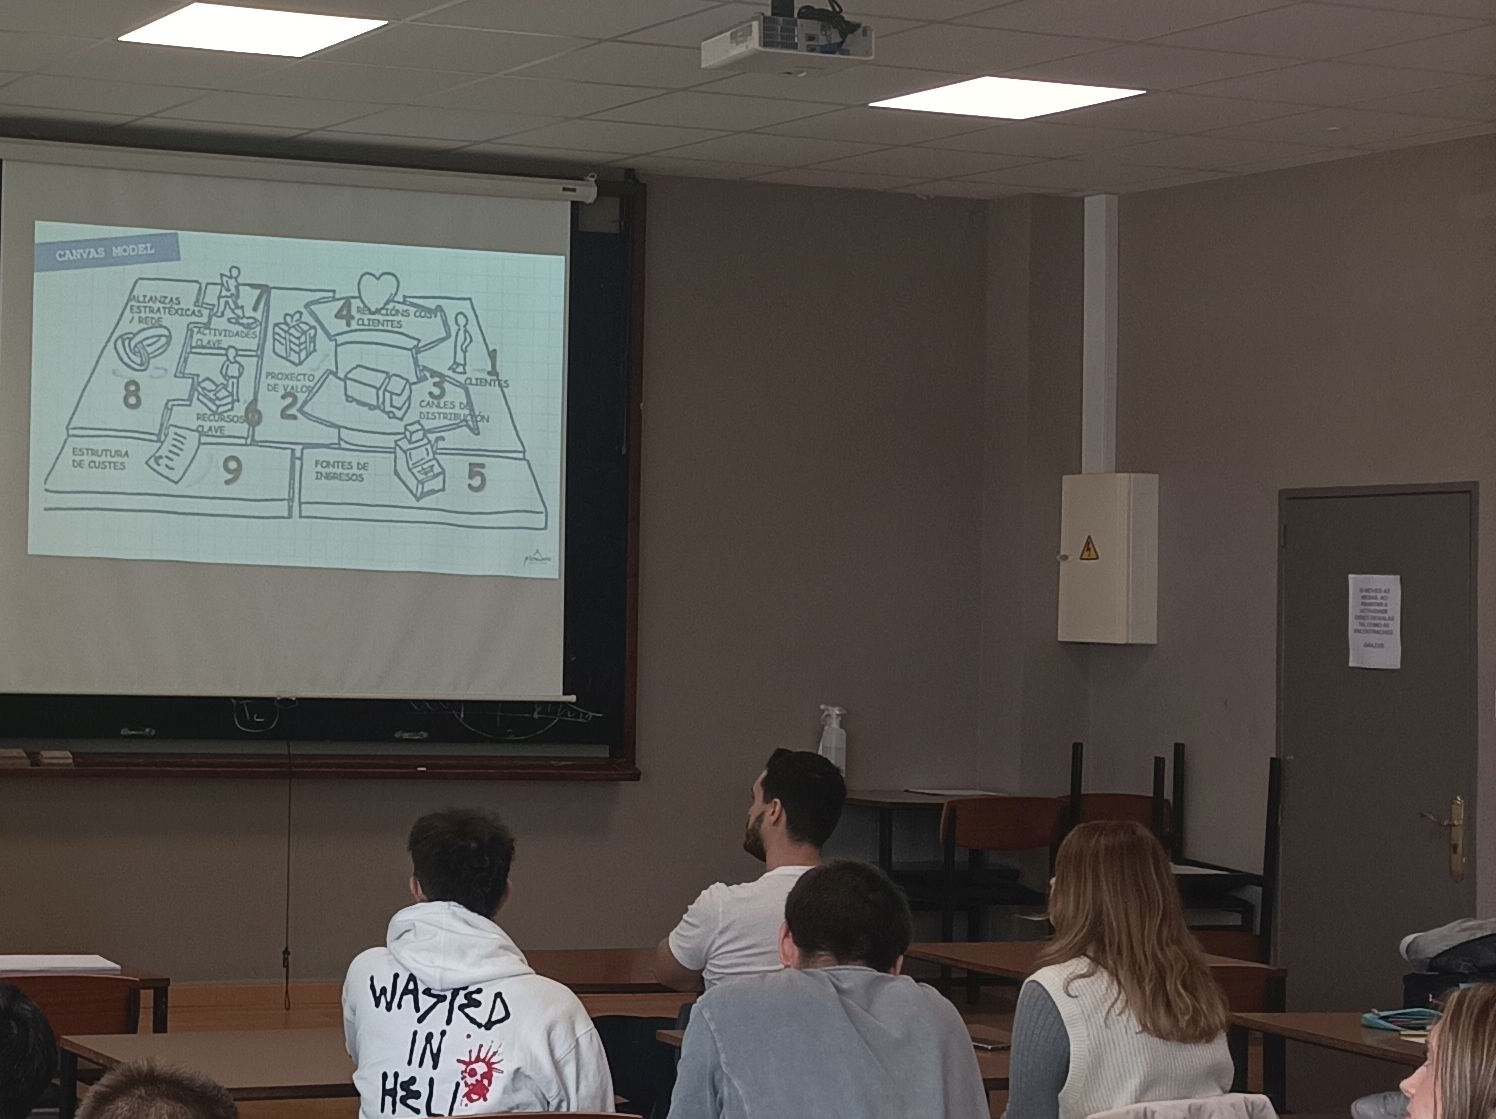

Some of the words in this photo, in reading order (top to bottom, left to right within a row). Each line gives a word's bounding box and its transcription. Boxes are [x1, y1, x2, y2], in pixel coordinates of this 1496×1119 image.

[56, 247, 105, 261] CANVAS
[112, 243, 155, 257] MODEL
[131, 294, 181, 306] ALIANZAS
[250, 284, 271, 312] 7
[130, 304, 204, 318] ESTRATÉXICAS
[334, 297, 355, 328] 4
[138, 315, 164, 326] REDE
[357, 318, 403, 329] CLIENTES
[196, 326, 258, 339] ACTIVIDADES
[487, 348, 499, 376] 1
[266, 371, 315, 382] PROXECTO
[465, 377, 510, 388] CLIENTES
[267, 383, 279, 393] DE
[282, 383, 313, 394] VALOR
[428, 373, 446, 400] 3
[123, 379, 142, 410] 8
[279, 391, 298, 420] 2
[196, 412, 246, 424] RECURSOS
[244, 400, 263, 428] 6
[419, 410, 490, 423] DISTRIBUCIÓN
[196, 424, 226, 435] CLAVE
[72, 447, 129, 459] ESTRUTURA
[72, 459, 85, 469] DE
[88, 459, 126, 471] CUSTES
[222, 455, 243, 486] 9
[315, 459, 353, 471] FONTES
[357, 461, 369, 471] DE
[315, 471, 365, 482] INGRESOS
[467, 462, 487, 492] 5
[369, 971, 511, 1031] WASTED
[407, 1029, 447, 1071] IN
